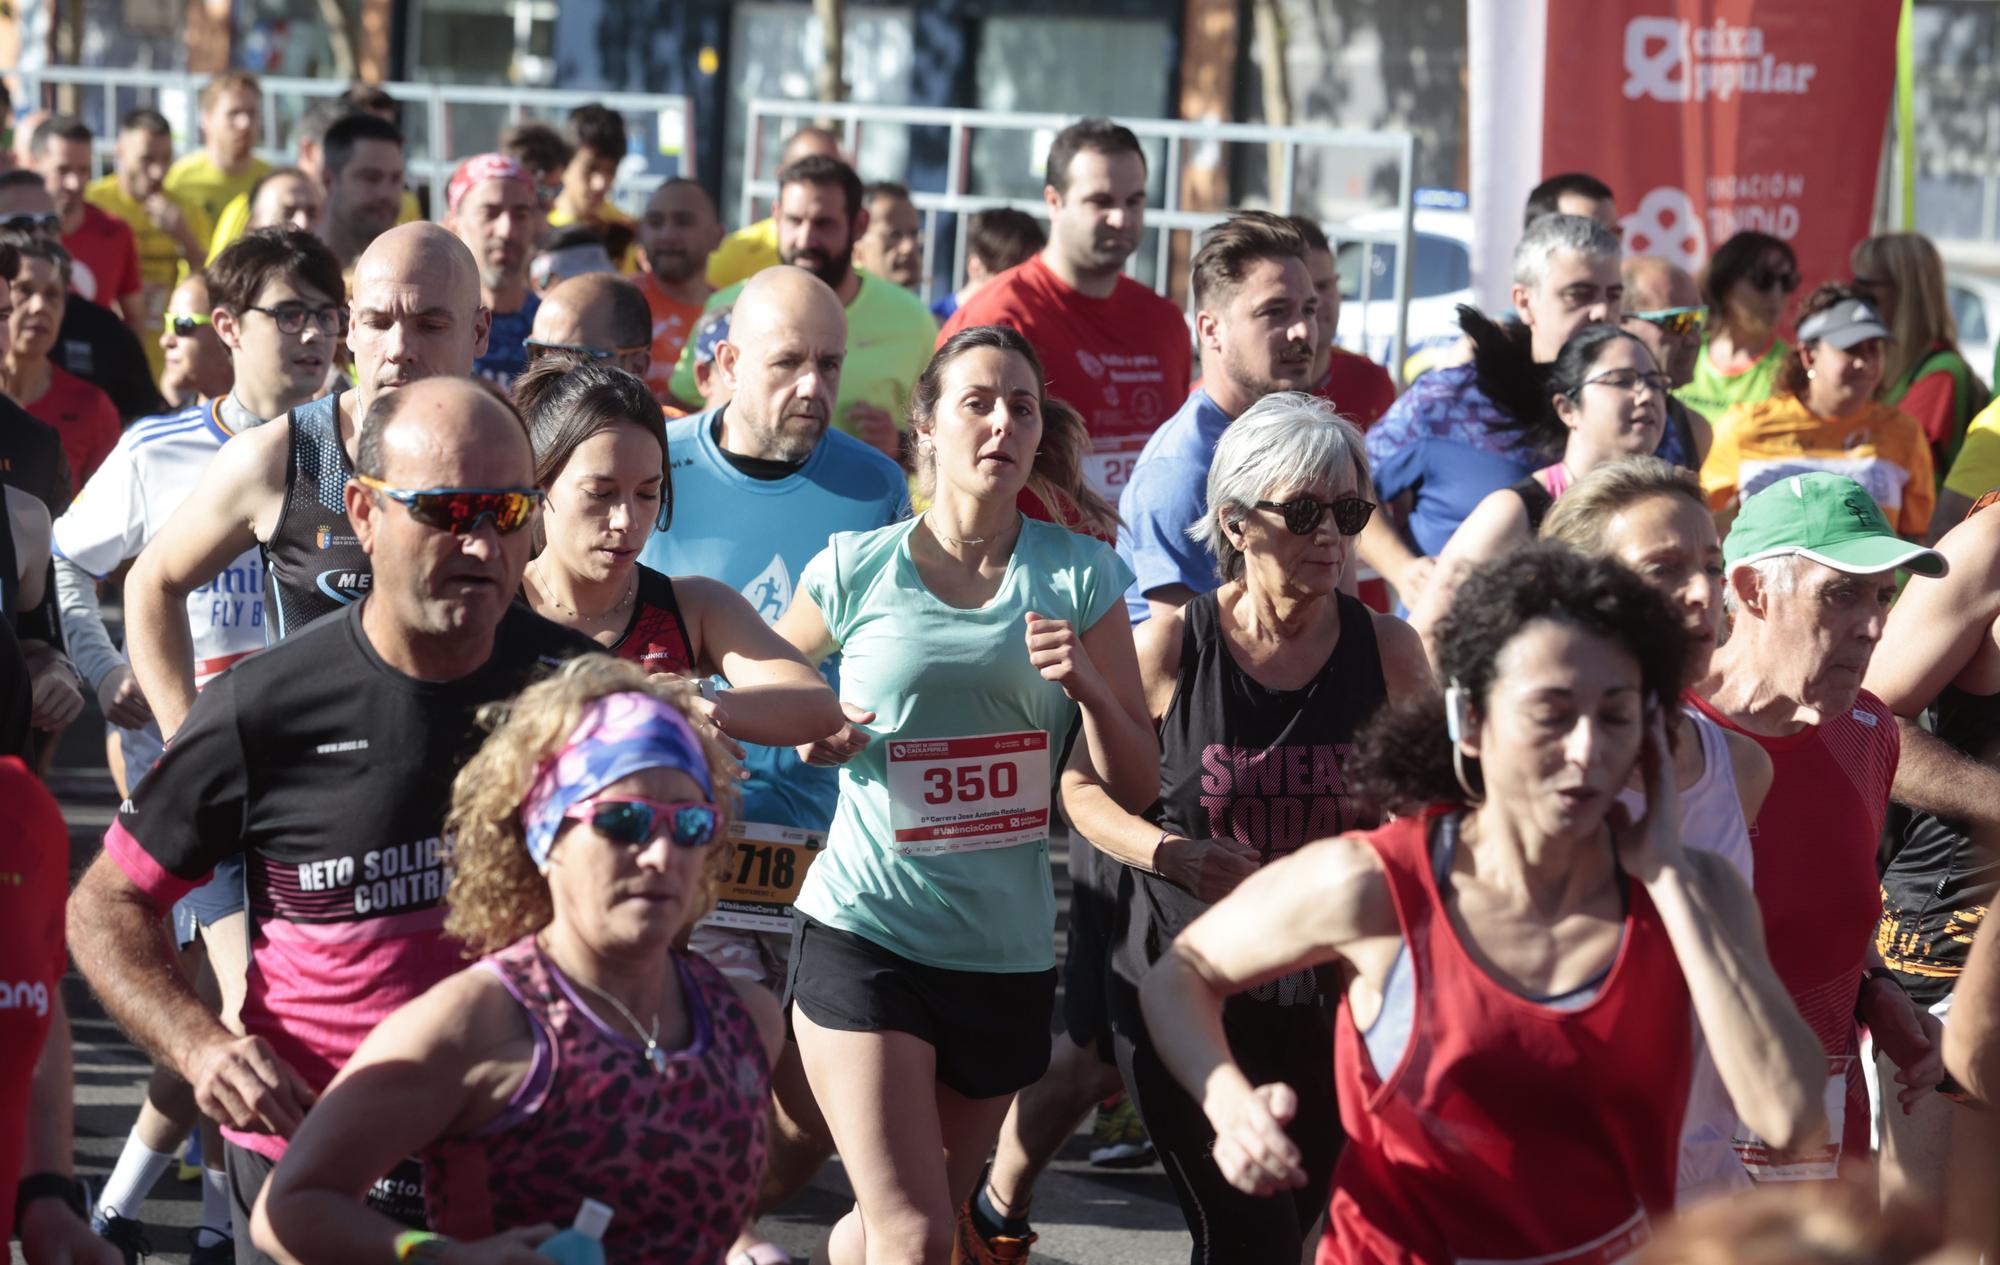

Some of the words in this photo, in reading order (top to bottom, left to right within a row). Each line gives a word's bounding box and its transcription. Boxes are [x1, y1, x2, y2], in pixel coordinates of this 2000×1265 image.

[211, 600, 245, 627] FLY
[924, 762, 1017, 804] 350
[298, 855, 355, 892] RETO
